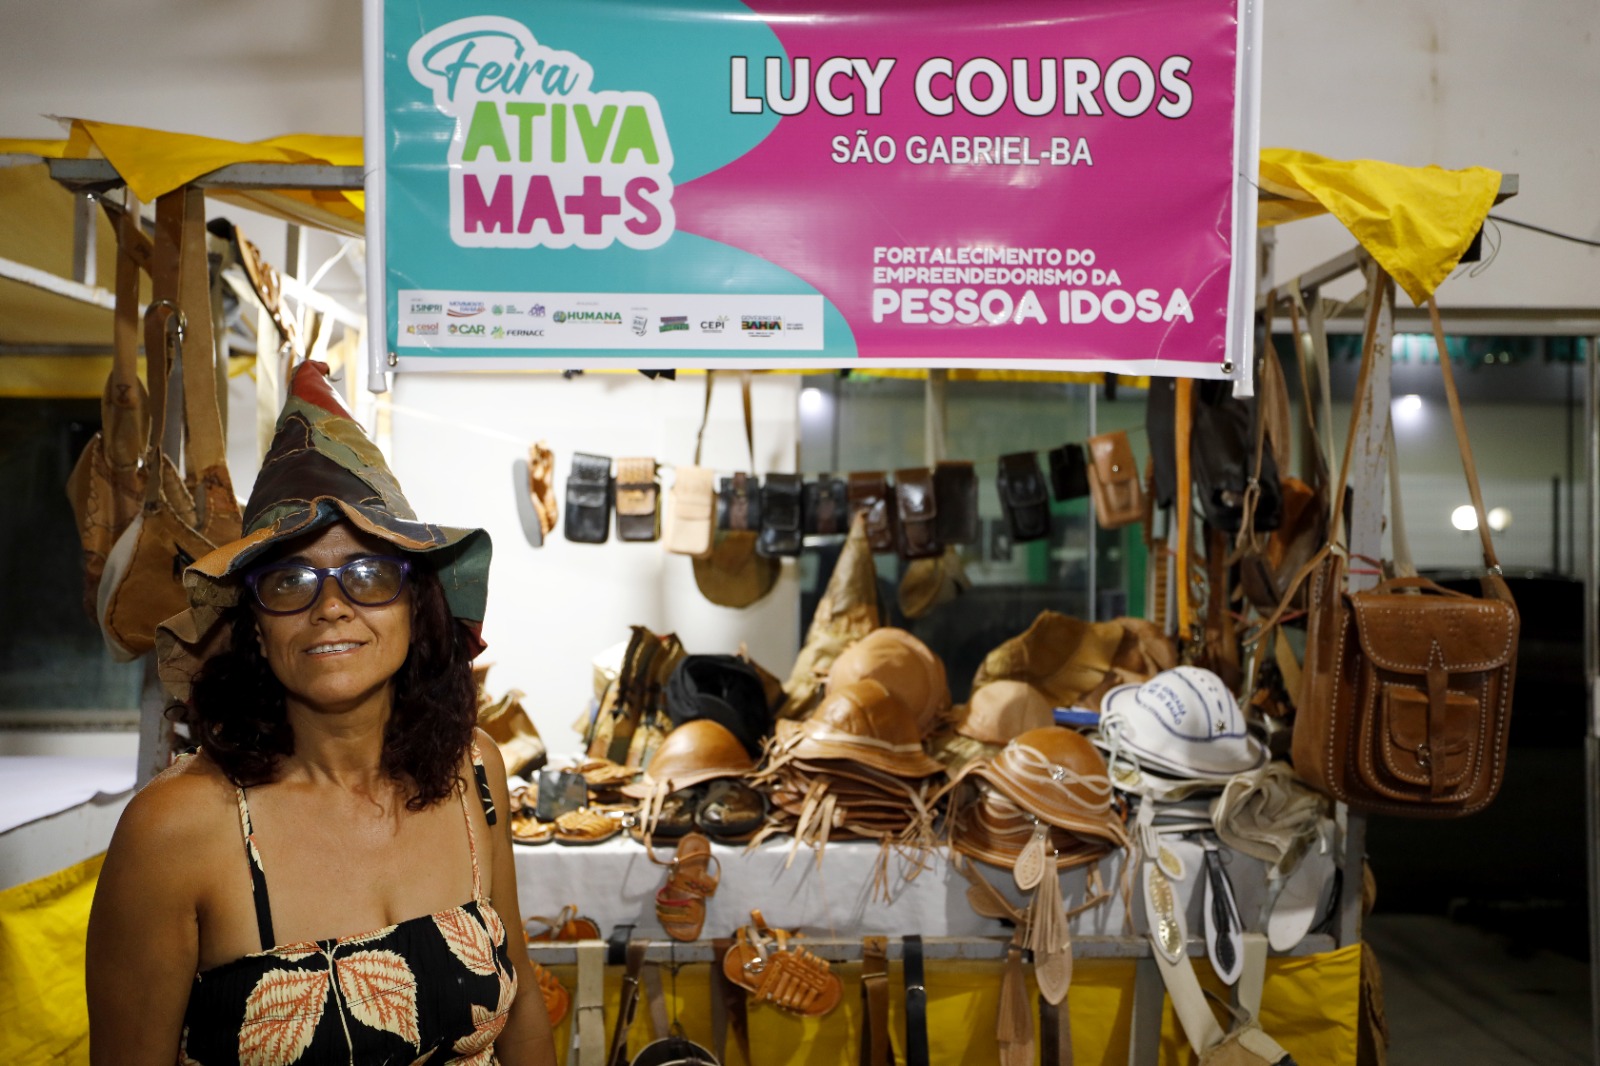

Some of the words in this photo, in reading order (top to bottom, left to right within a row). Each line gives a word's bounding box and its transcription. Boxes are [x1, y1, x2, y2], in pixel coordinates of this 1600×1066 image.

[422, 30, 579, 103] Feira
[729, 56, 896, 115] LUCY
[914, 55, 1194, 118] COUROS
[461, 101, 660, 164] ATIVA
[831, 130, 896, 164] SÃO
[905, 135, 1093, 166] GABRIEL-BA
[873, 247, 1062, 266] FORTALECIMENTO
[1065, 249, 1096, 266] DO
[873, 267, 1088, 286] EMPREENDEDORISMO
[1091, 268, 1122, 286] DA
[567, 311, 622, 320] HUMANA
[872, 288, 1048, 324] PESSOA
[1058, 288, 1195, 324] IDOSA
[458, 324, 485, 334] CAR
[700, 321, 725, 329] CEPI
[741, 321, 782, 330] BAHIA
